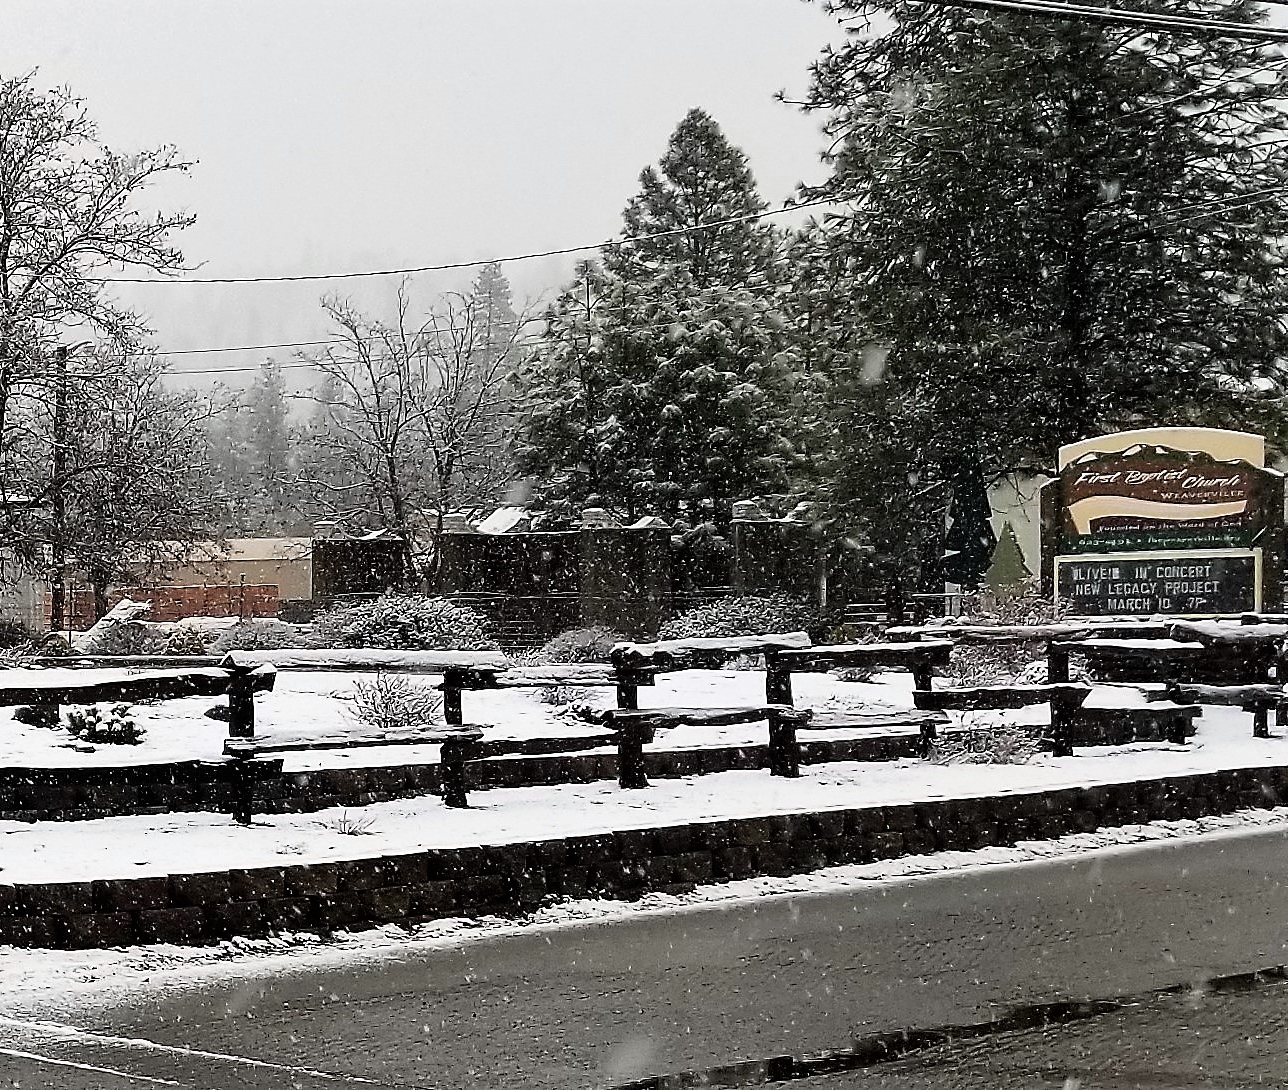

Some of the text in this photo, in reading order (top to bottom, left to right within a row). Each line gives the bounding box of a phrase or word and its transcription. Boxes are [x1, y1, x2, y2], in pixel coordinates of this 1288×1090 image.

[1074, 468, 1241, 489] First Baptist Church
[1161, 490, 1245, 499] WEAVERVILLE
[1135, 567, 1148, 580] IN
[1156, 565, 1212, 579] CONCERT
[1075, 580, 1220, 596] NEW LEGACY PROJECT
[1108, 598, 1151, 611] MARCH
[1158, 598, 1171, 610] 10
